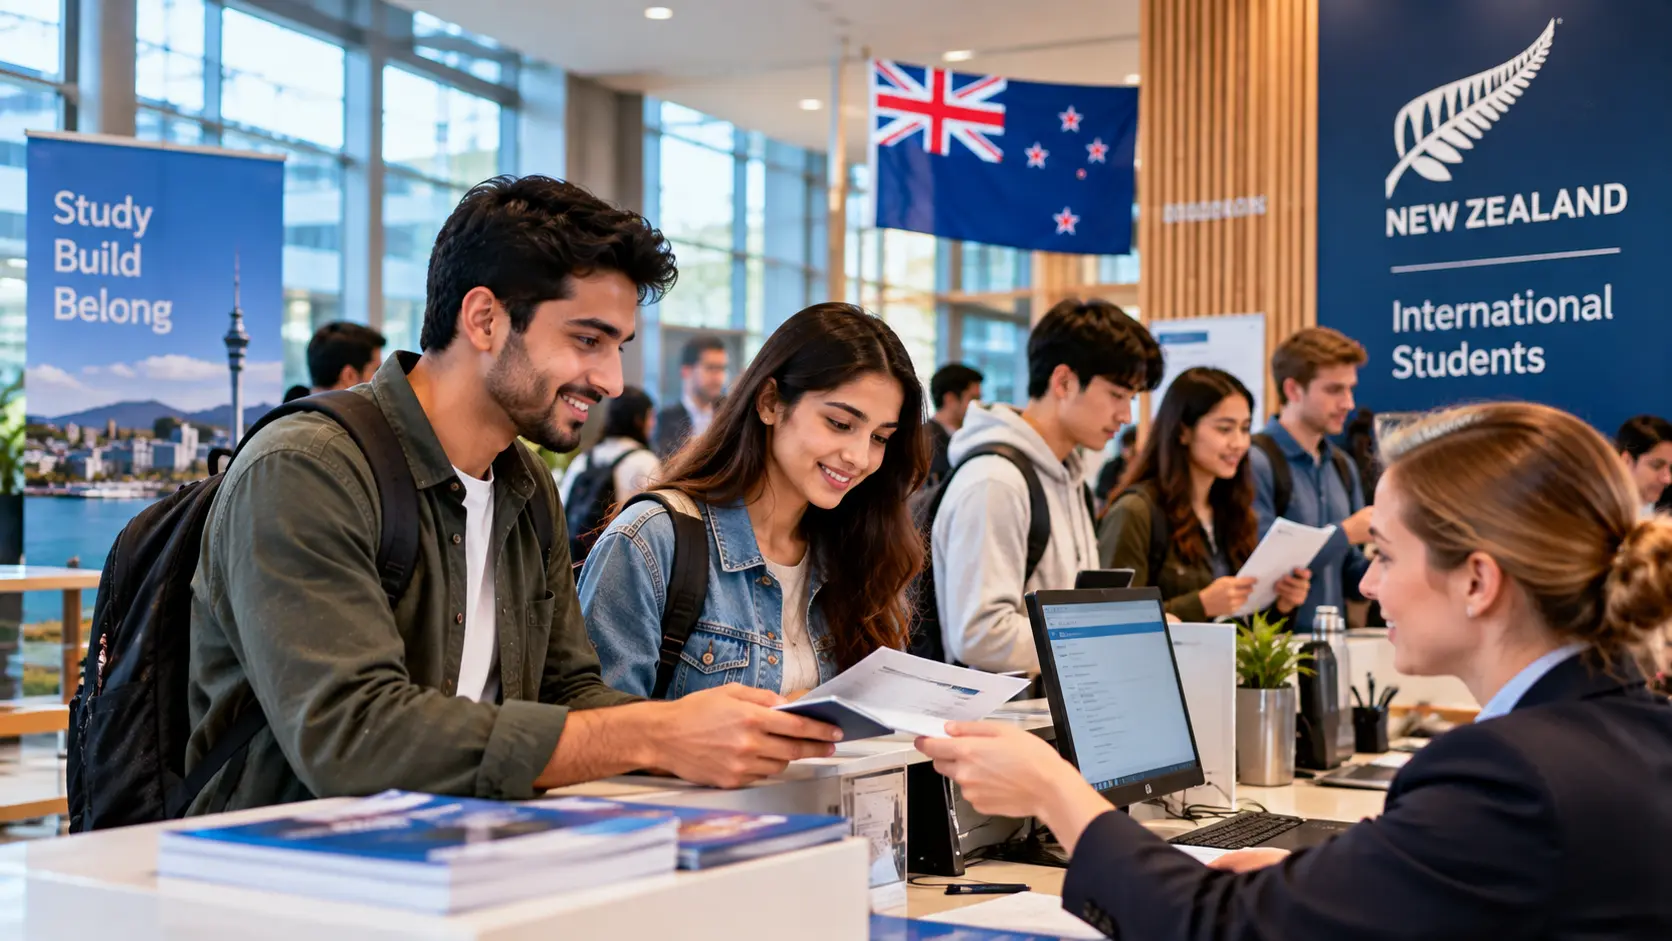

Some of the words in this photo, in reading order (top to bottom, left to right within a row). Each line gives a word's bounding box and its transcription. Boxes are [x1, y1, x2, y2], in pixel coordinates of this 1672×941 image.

[53, 190, 153, 238] Study
[1385, 201, 1459, 237] NEW
[1465, 182, 1628, 229] ZEALAND
[54, 238, 142, 277] Build
[54, 286, 173, 335] Belong
[1393, 283, 1613, 333] International
[1392, 341, 1546, 379] Students
